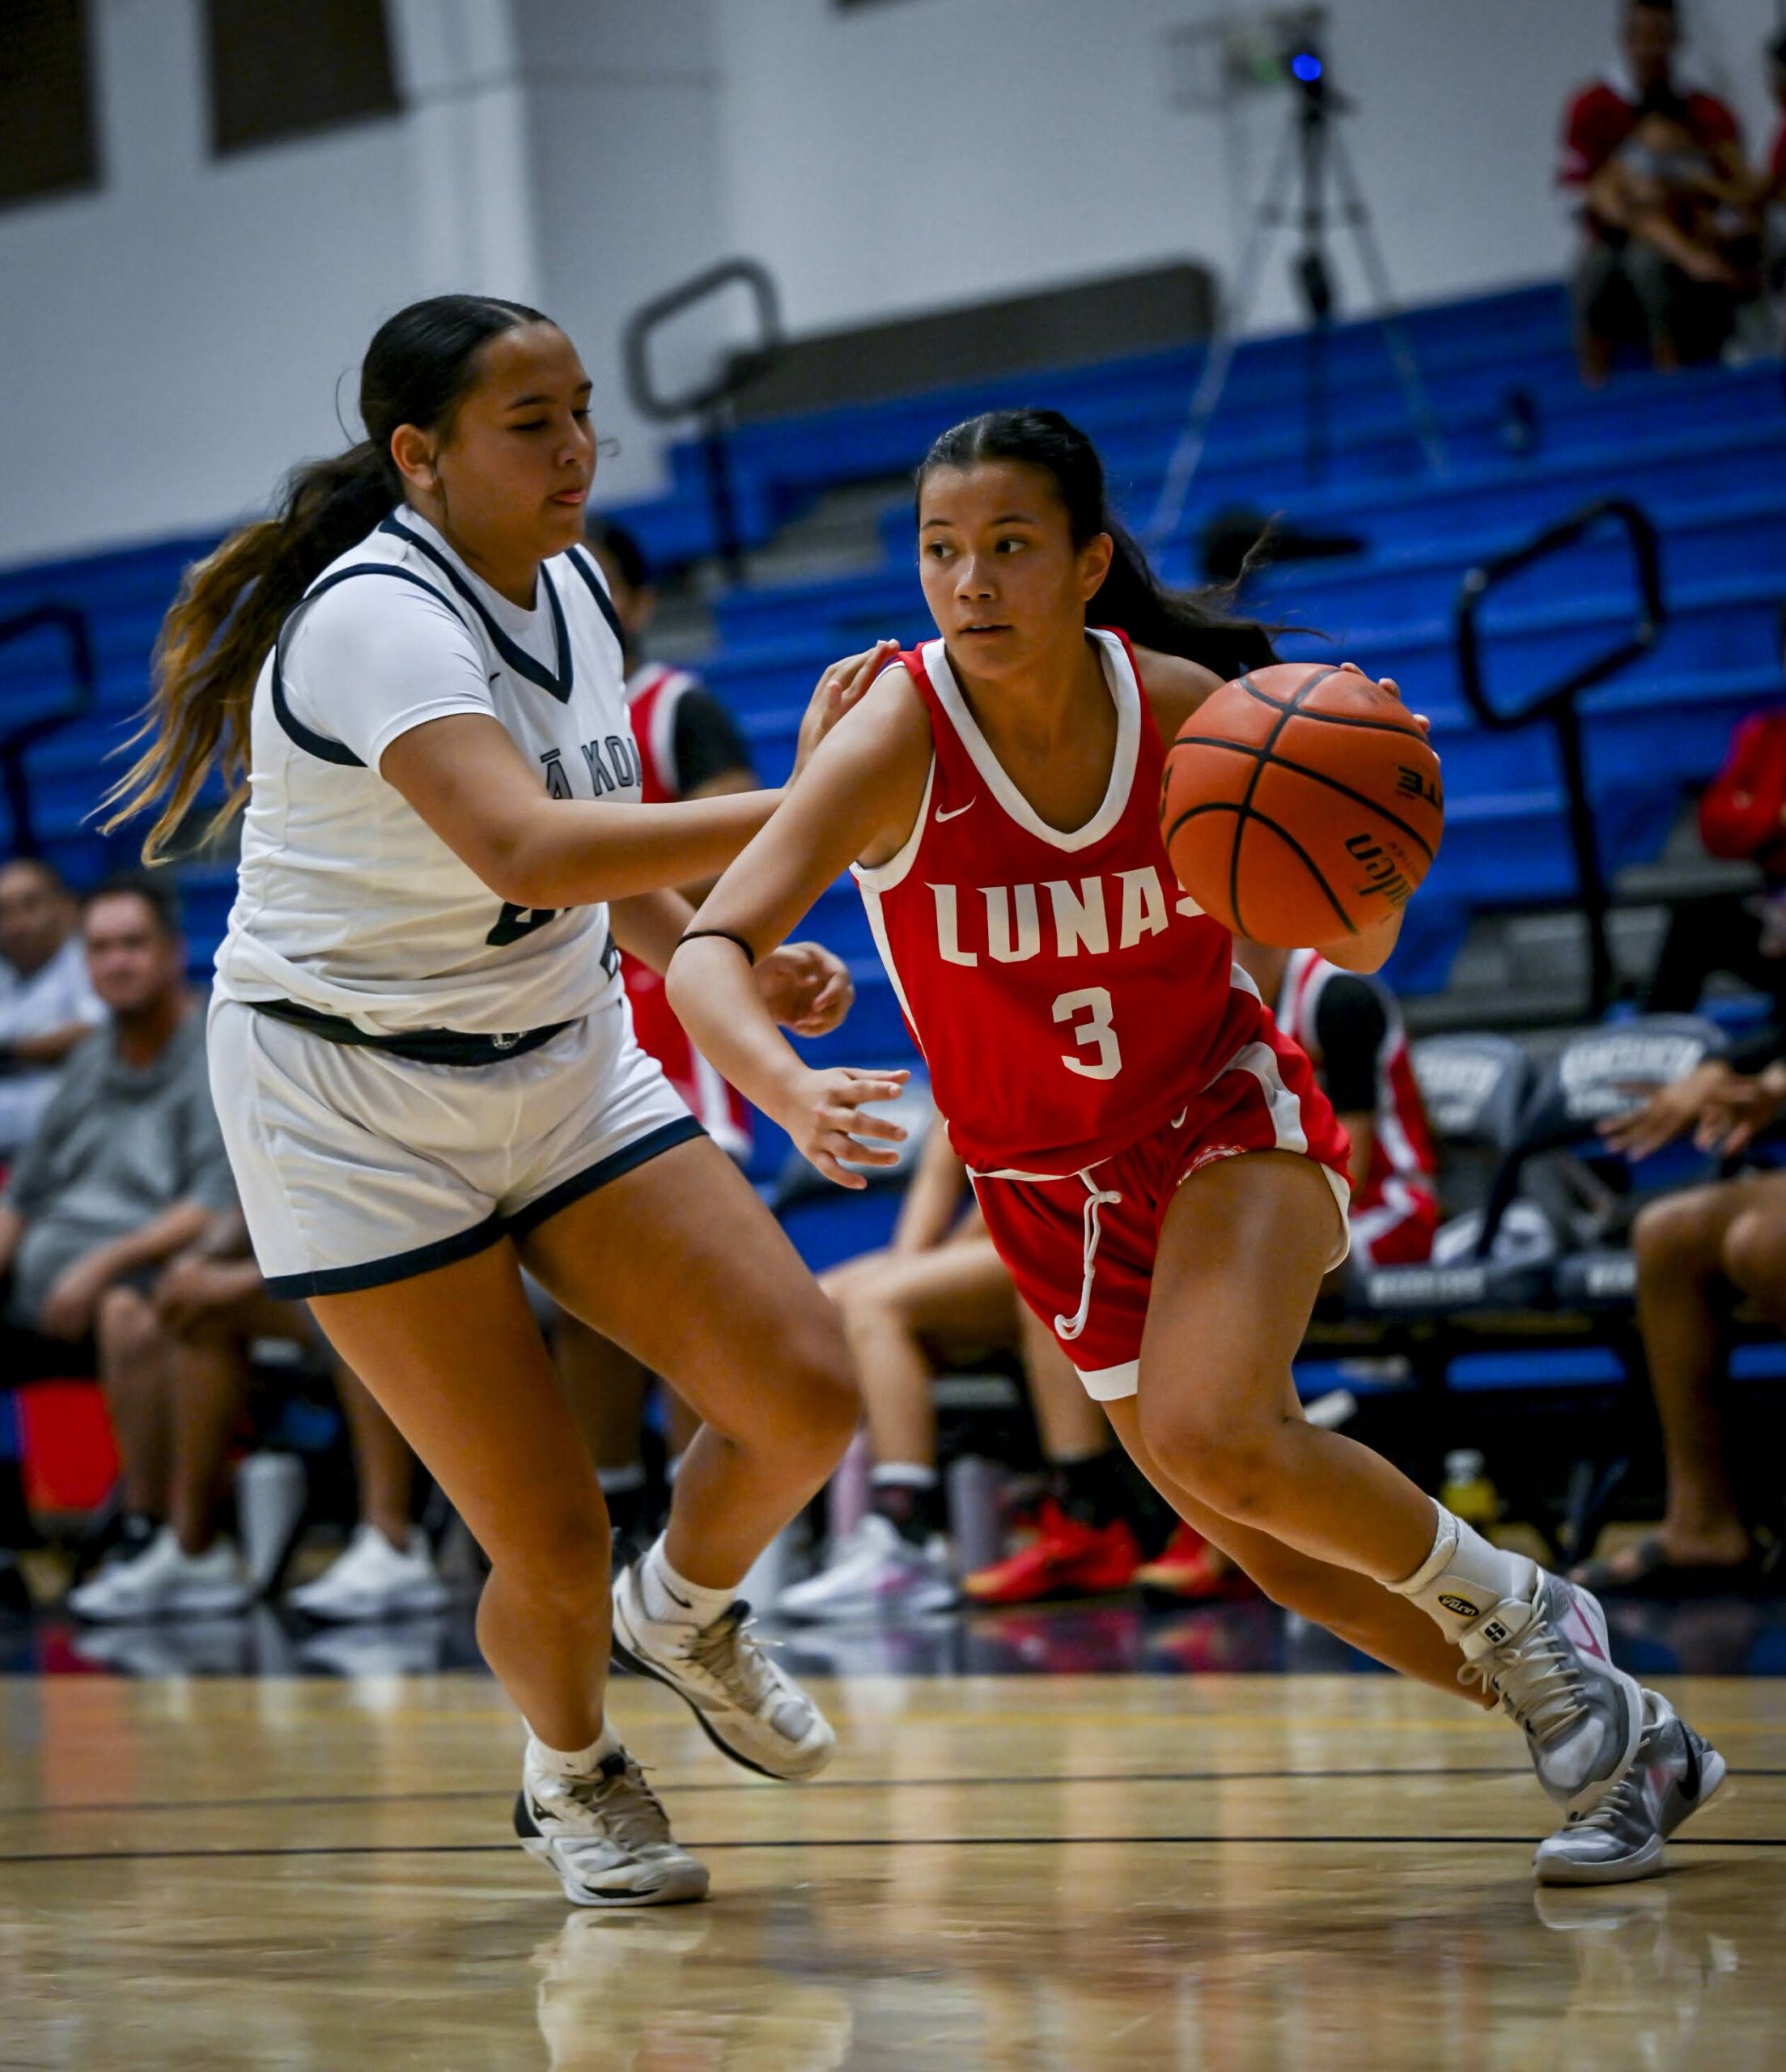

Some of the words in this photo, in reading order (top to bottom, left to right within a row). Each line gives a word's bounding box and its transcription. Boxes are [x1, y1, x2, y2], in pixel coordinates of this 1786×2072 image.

[580, 734, 643, 797] KO
[1051, 986, 1122, 1081] 3
[1440, 1596, 1477, 1616] ULTRA
